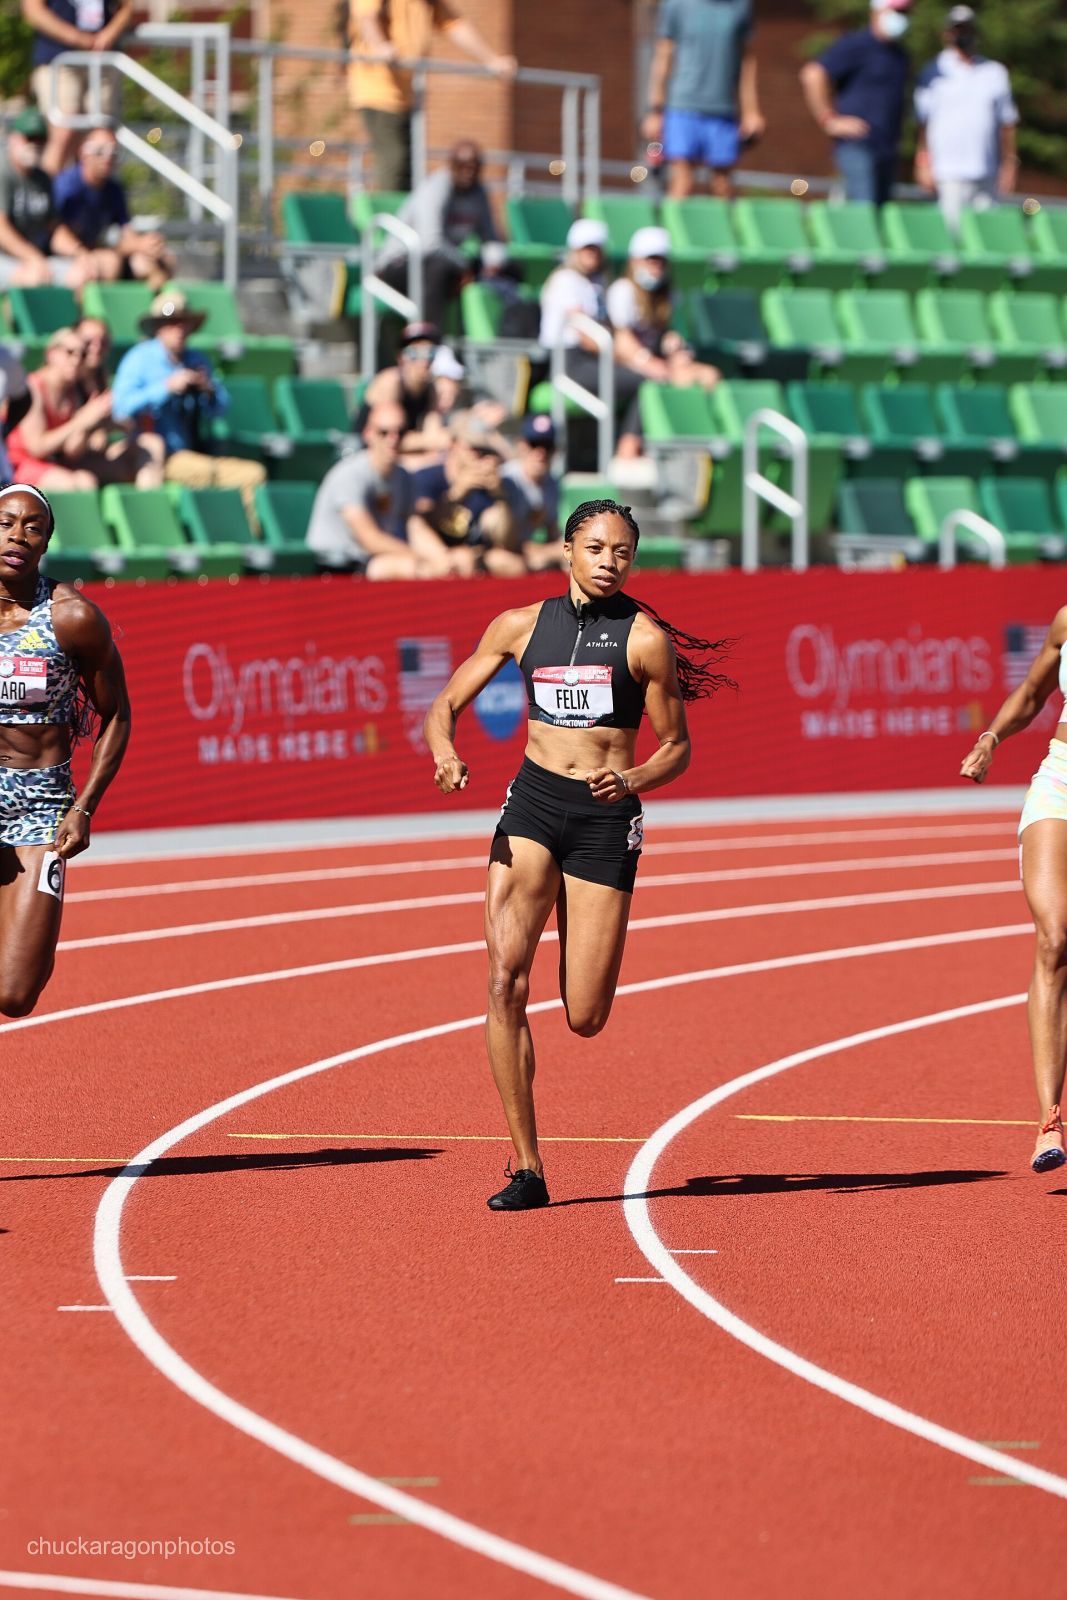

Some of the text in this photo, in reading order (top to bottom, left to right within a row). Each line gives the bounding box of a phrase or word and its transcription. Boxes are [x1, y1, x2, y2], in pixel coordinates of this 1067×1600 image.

[785, 622, 994, 708] Olympians
[183, 640, 388, 735] Olympians
[556, 689, 590, 710] FELIX
[802, 704, 950, 739] MADE HERE
[198, 729, 348, 764] MADE HERE
[47, 858, 62, 894] 6
